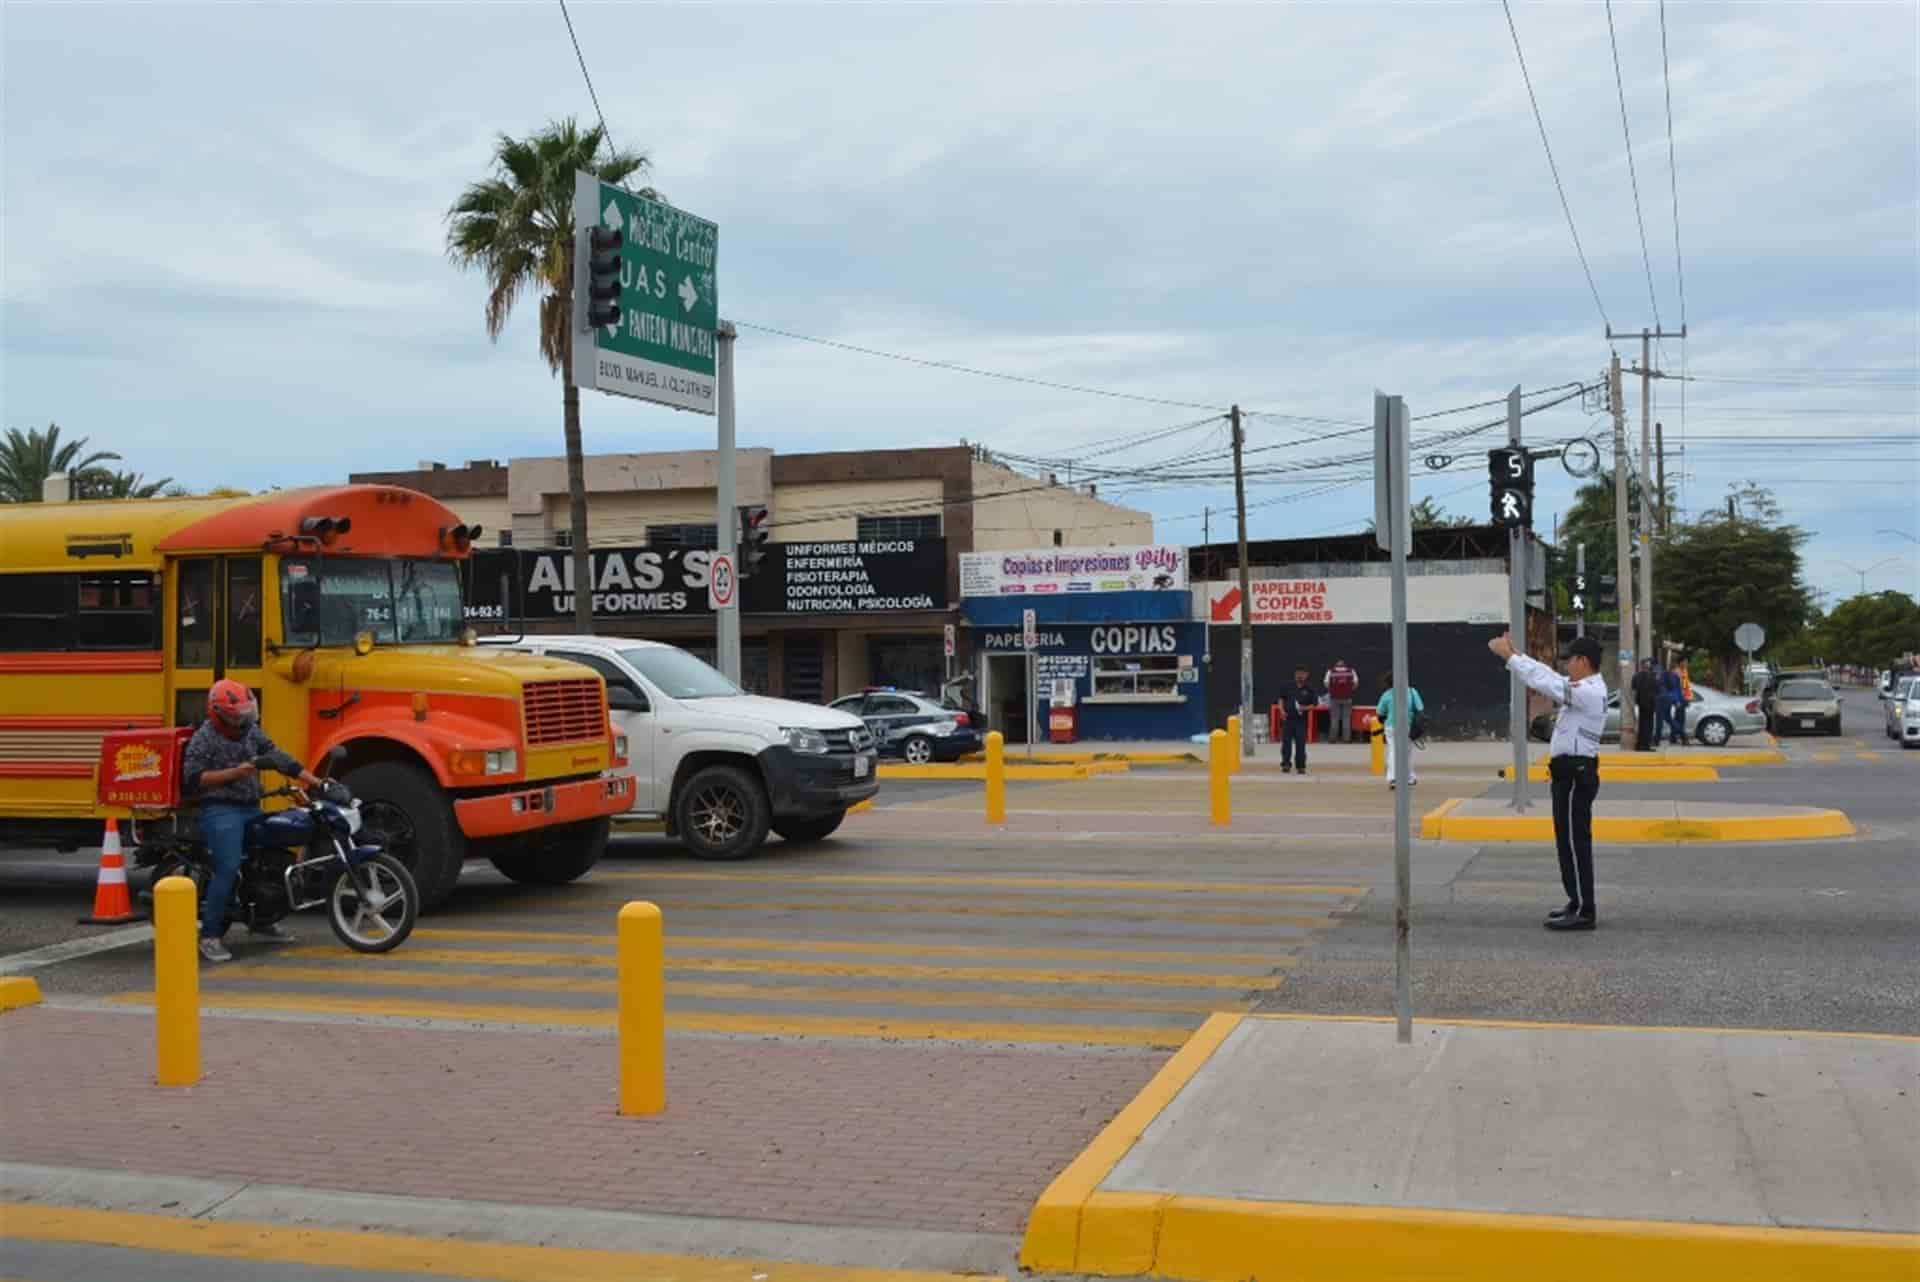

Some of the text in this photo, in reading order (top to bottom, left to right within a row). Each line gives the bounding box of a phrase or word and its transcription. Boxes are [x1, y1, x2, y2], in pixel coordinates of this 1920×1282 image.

[620, 260, 667, 299] UAS
[786, 540, 915, 556] UNIFORMES MÉDICOS
[786, 556, 864, 569] ENFERMERÍA
[1003, 557, 1042, 579] Copias
[1055, 555, 1130, 577] Impresiones
[786, 570, 869, 583] FISIOTERAPIA
[786, 583, 876, 597] ODONTOLOGÍA
[1252, 582, 1328, 594] PAPELERIA
[553, 591, 687, 614] UFORMES
[858, 594, 933, 609] PSICOLOGÍA
[1256, 595, 1325, 610] COPIAS
[985, 632, 1065, 648] PAPEERIA
[1091, 626, 1177, 654] COPIAS
